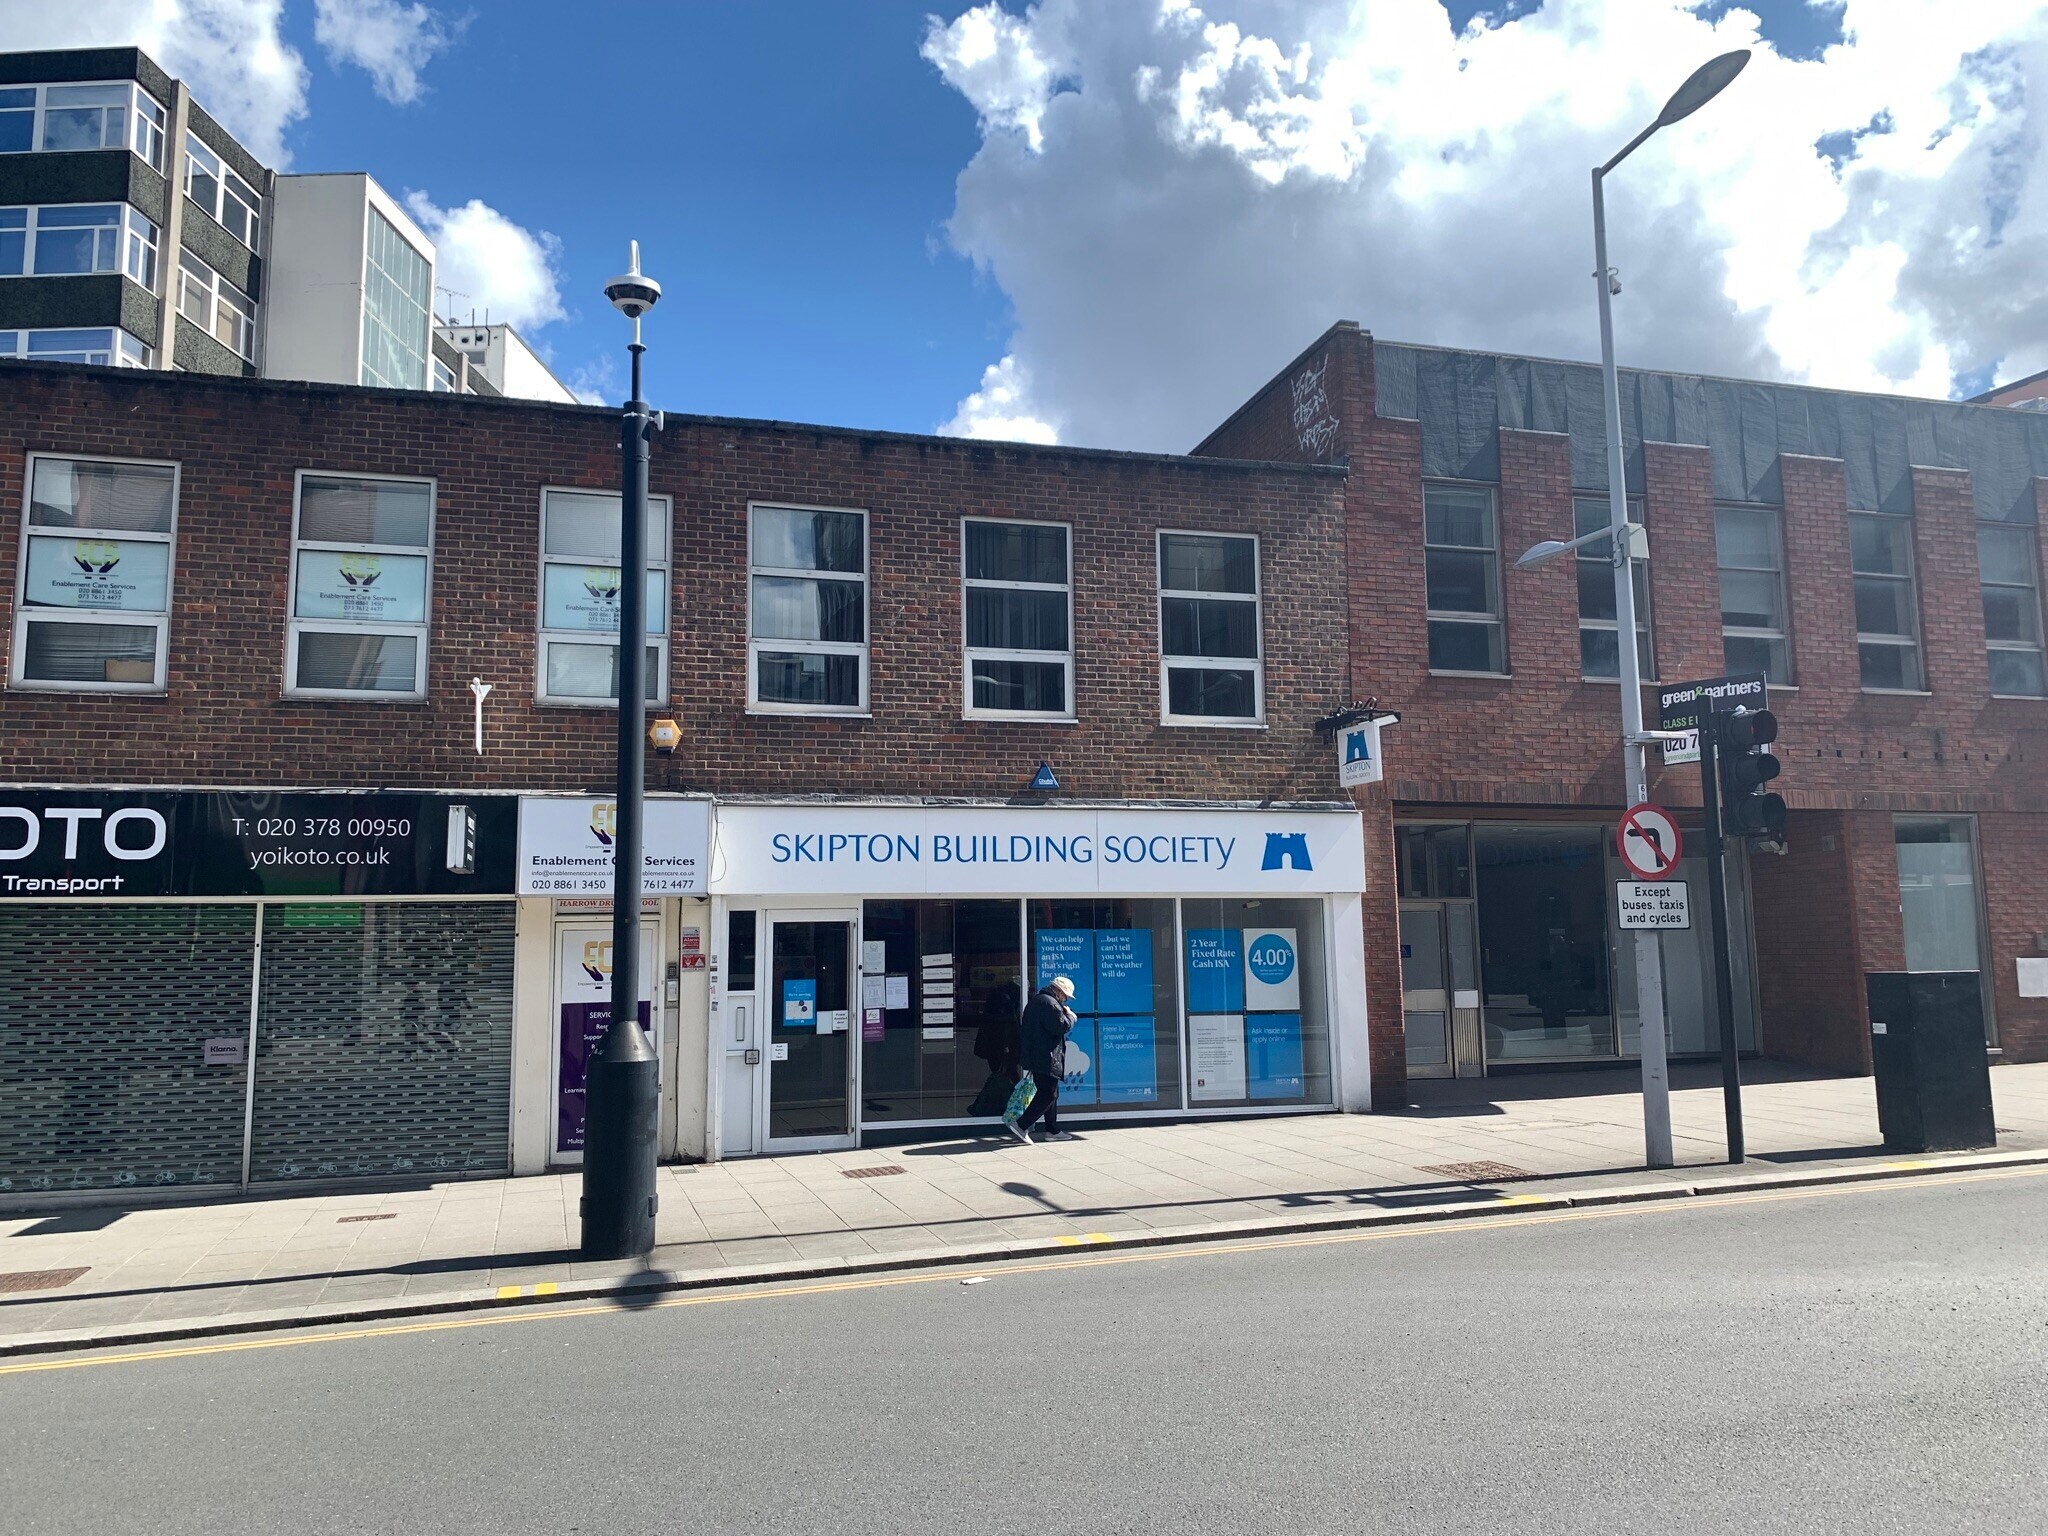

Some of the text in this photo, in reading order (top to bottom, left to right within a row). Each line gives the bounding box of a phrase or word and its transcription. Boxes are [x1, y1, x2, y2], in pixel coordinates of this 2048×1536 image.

[52, 580, 91, 588] Enablement
[320, 592, 355, 600] Enablement
[1663, 717, 1686, 729] CLASS
[1689, 716, 1694, 725] E
[1345, 761, 1371, 774] SKIPTON
[592, 804, 616, 836] EC
[232, 818, 411, 837] T: 020 378 00950
[771, 834, 1236, 871] SKIPTON BUILDING SOCIETY
[250, 847, 390, 870] yoikoto.co.uk
[532, 856, 607, 866] Enablement
[645, 856, 695, 866] Services
[3, 875, 124, 894] Transport
[532, 880, 694, 889] 020 8861 3450 7612 4477
[1635, 887, 1670, 897] Except
[1660, 900, 1684, 910] taxis
[1627, 913, 1682, 924] and cycles
[1042, 935, 1054, 943] We
[1068, 935, 1084, 944] help
[1191, 939, 1218, 948] 2 Year
[585, 941, 613, 973] EC
[1192, 949, 1236, 958] Fixed Rate
[1062, 962, 1080, 970] right
[1101, 961, 1142, 969] the weather
[1192, 959, 1230, 968] Cash ISA
[590, 1011, 612, 1019] SERVIC
[1115, 1042, 1143, 1050] questions
